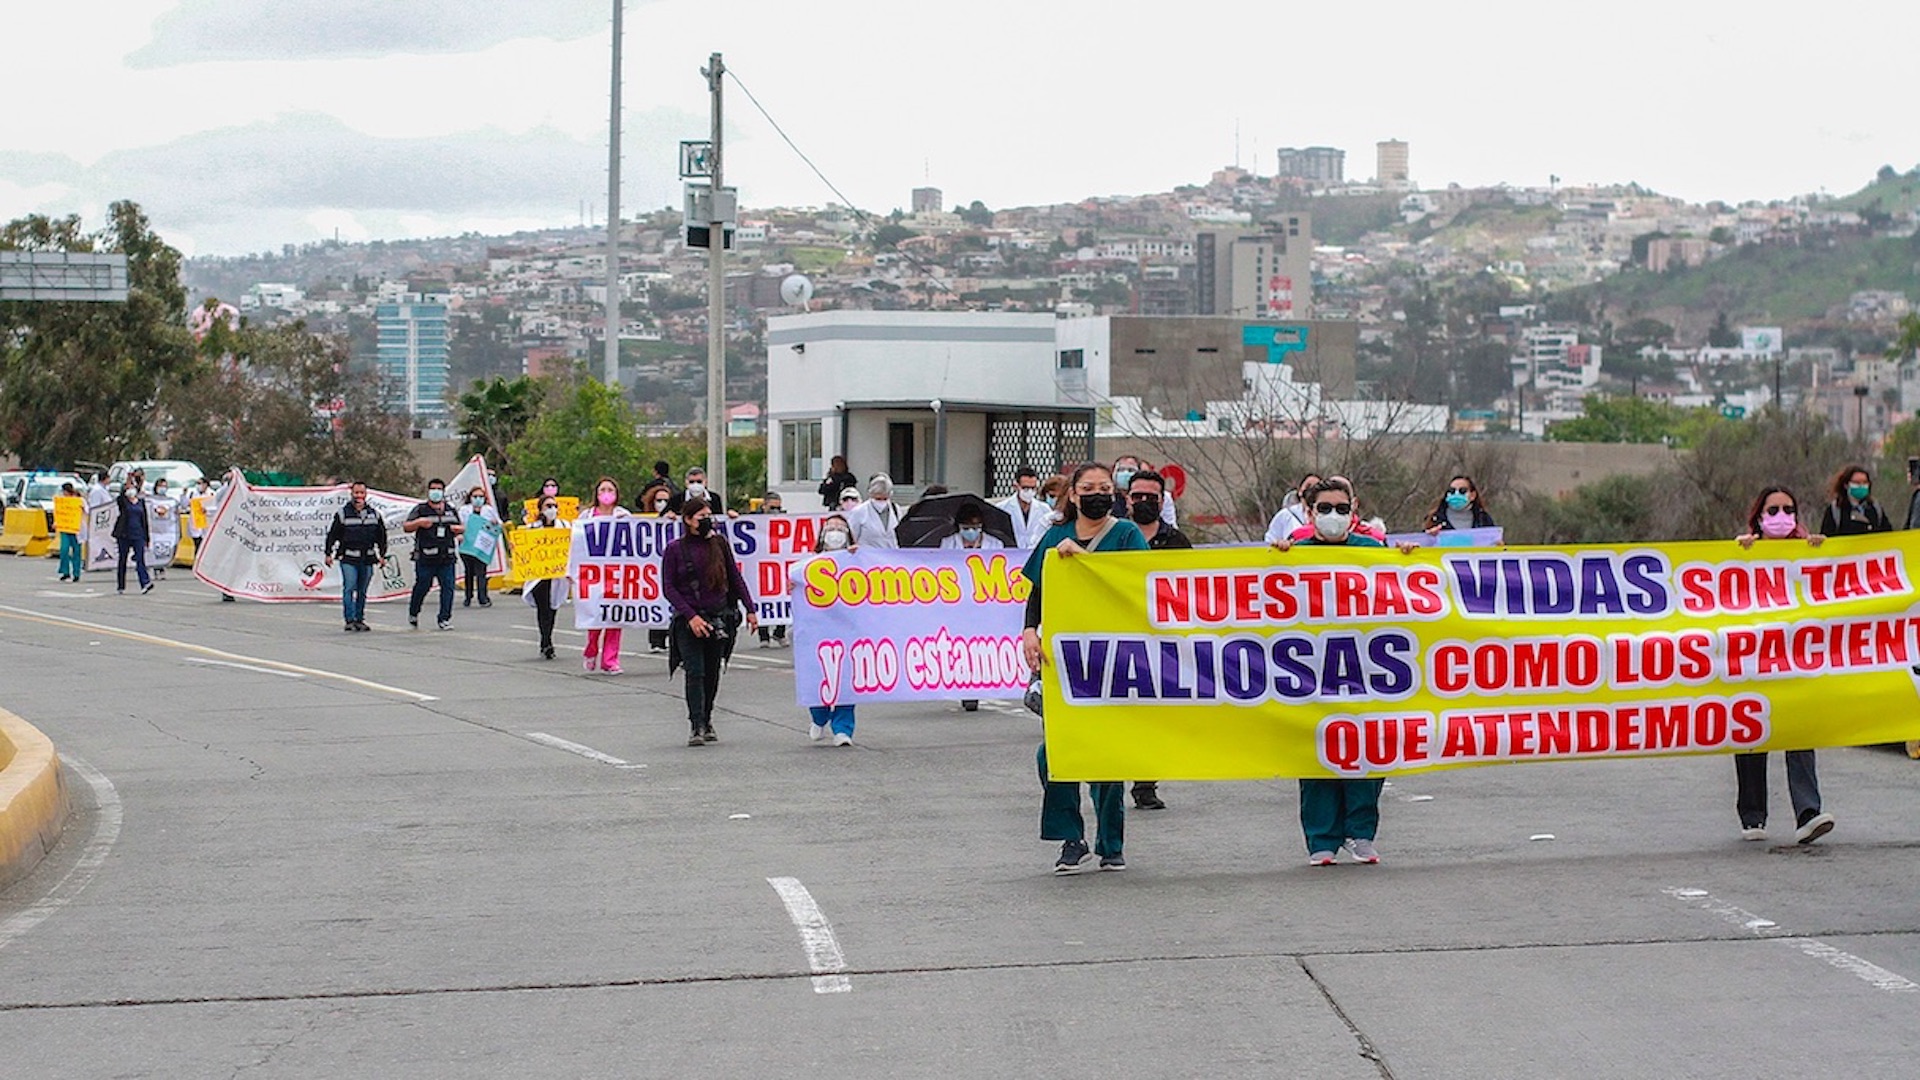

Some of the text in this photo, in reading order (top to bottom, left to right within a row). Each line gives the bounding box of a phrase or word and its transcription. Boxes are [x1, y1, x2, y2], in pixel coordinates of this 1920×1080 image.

[584, 520, 756, 558] VACUS
[600, 603, 663, 624] TODOS
[804, 557, 962, 608] Somos
[1154, 555, 1905, 623] NUESTRAS VIDAS SON TAN
[818, 626, 1031, 706] y no estamos
[1059, 634, 1413, 700] VALIOSAS
[1434, 639, 1598, 692] COMO
[1616, 634, 1712, 683] LOS
[1323, 699, 1764, 772] QUE ATENDEMOS
